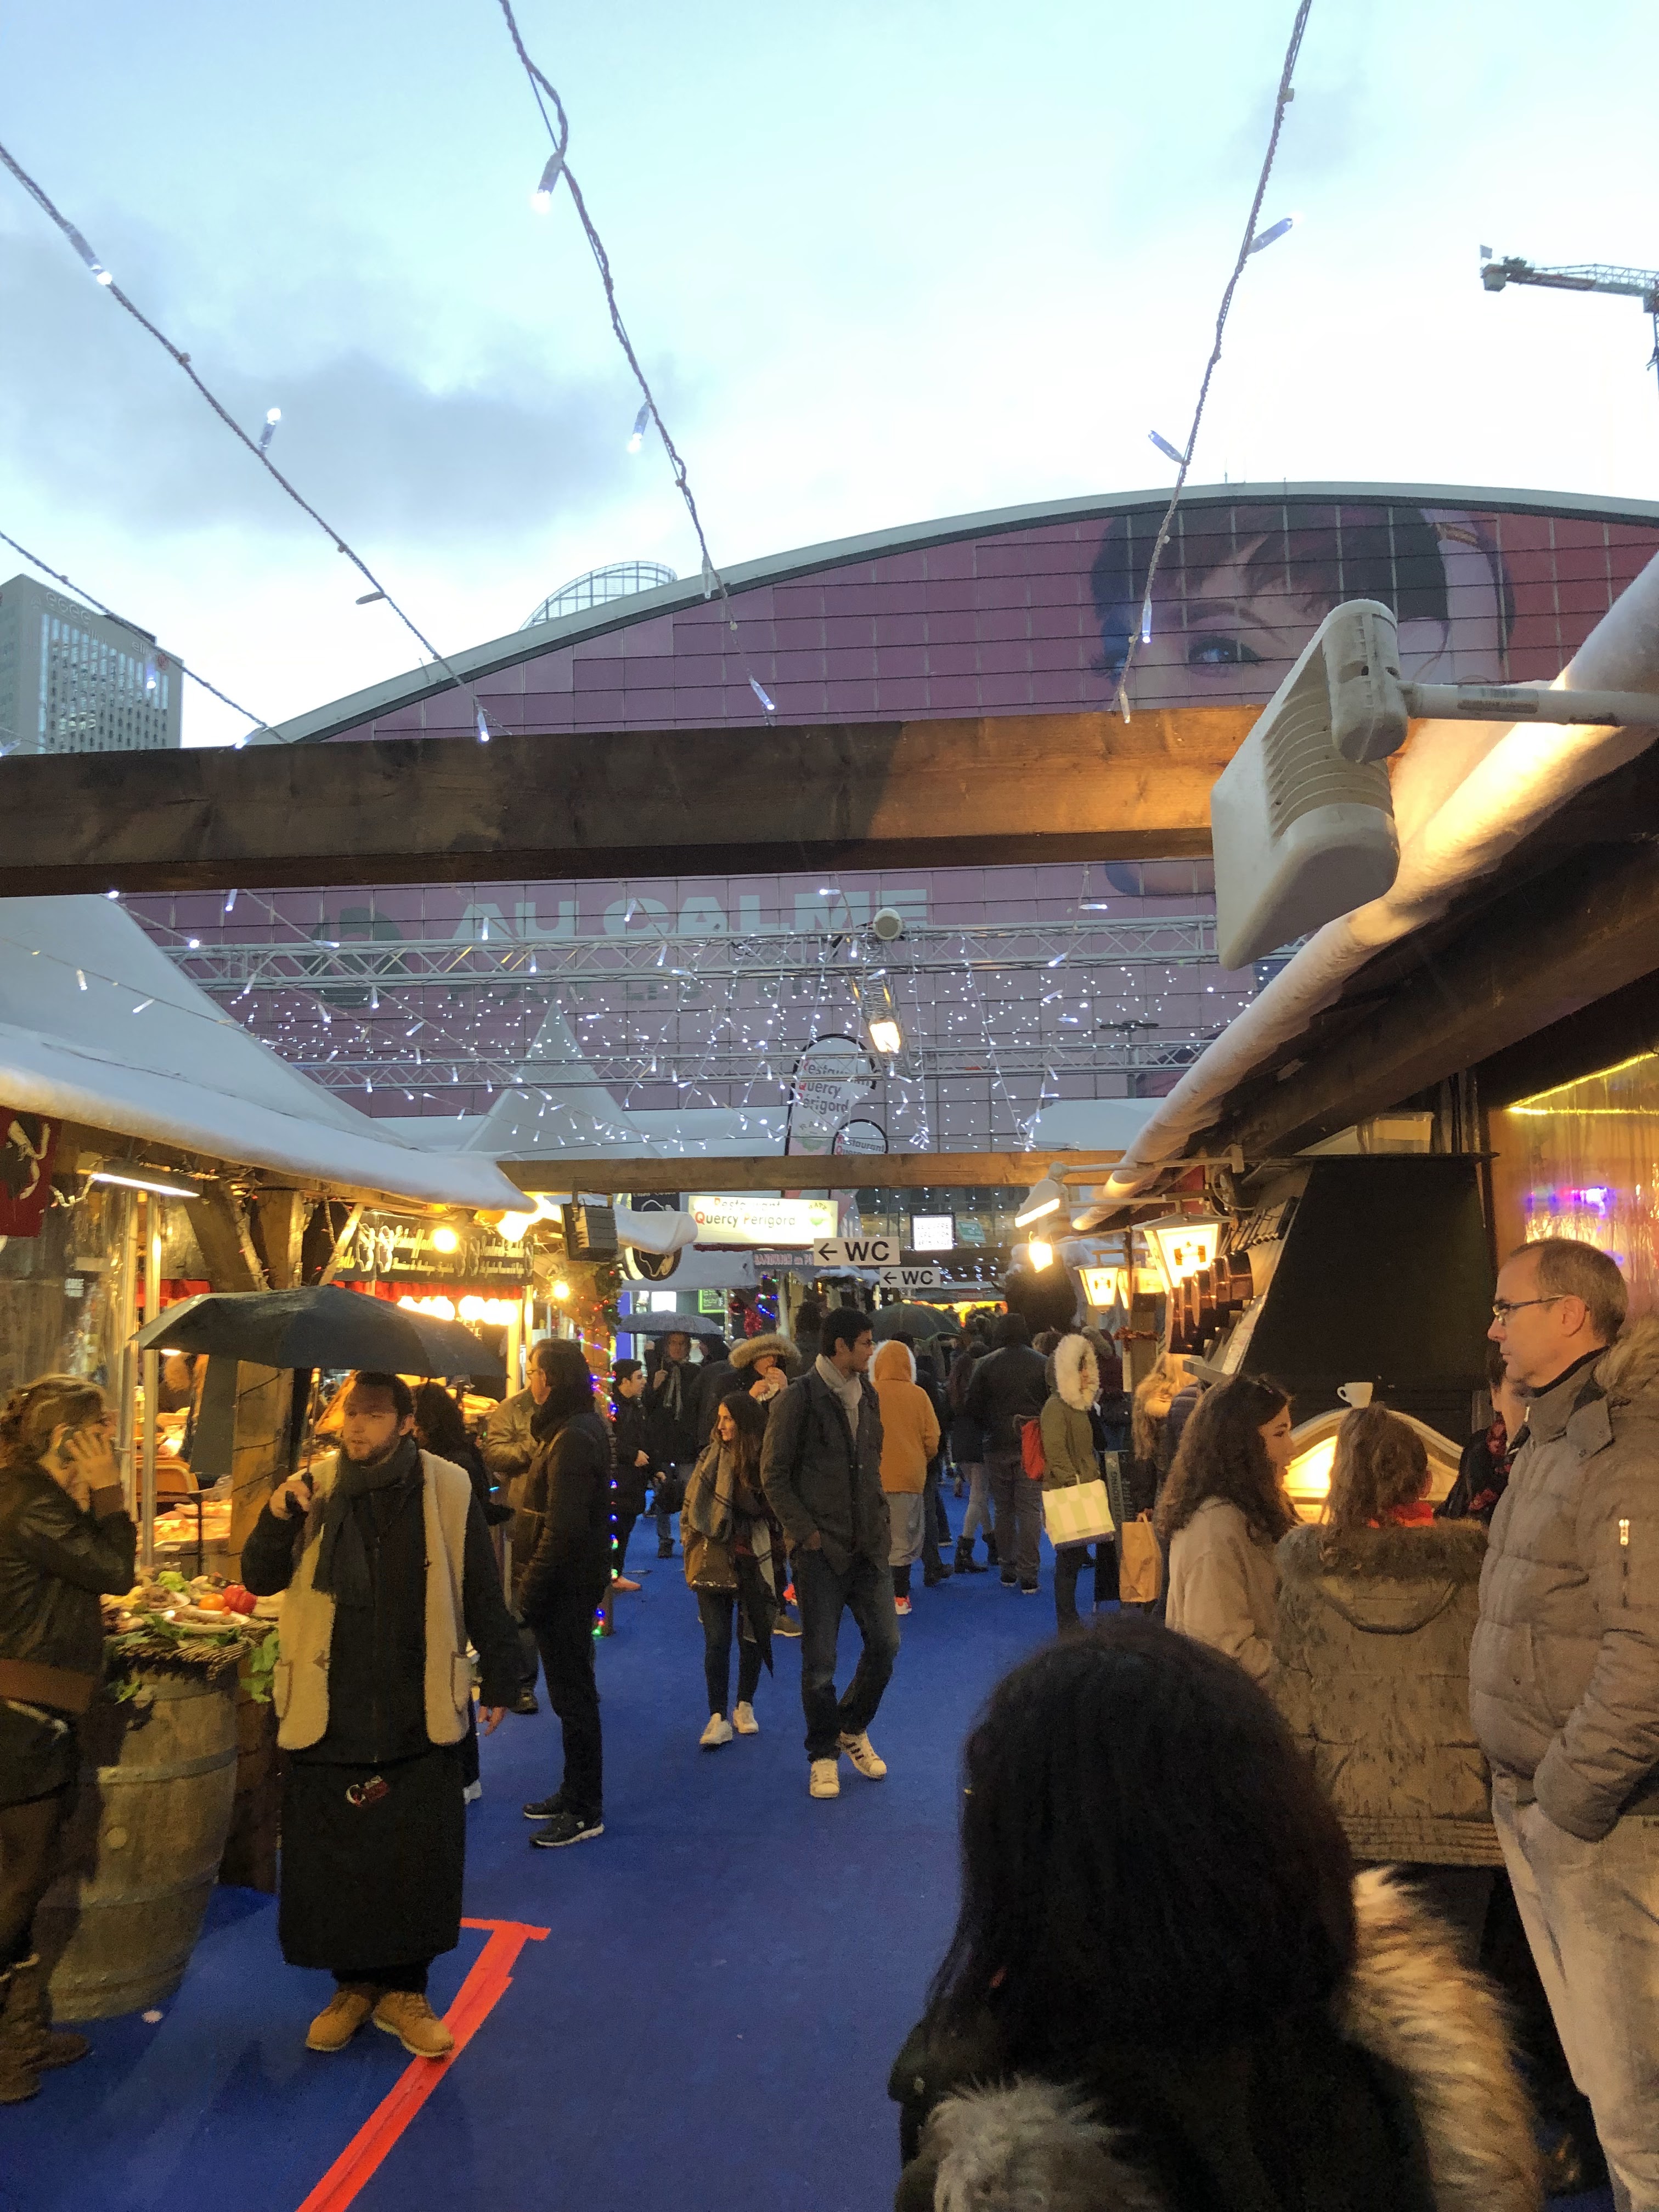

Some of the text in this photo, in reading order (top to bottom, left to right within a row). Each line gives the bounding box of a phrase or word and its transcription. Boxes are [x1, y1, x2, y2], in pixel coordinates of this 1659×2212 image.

[453, 900, 580, 940] AU
[798, 1082, 842, 1099] Quercy
[695, 1211, 738, 1228] Quercy
[844, 1240, 889, 1262] WC
[901, 1270, 934, 1285] WC
